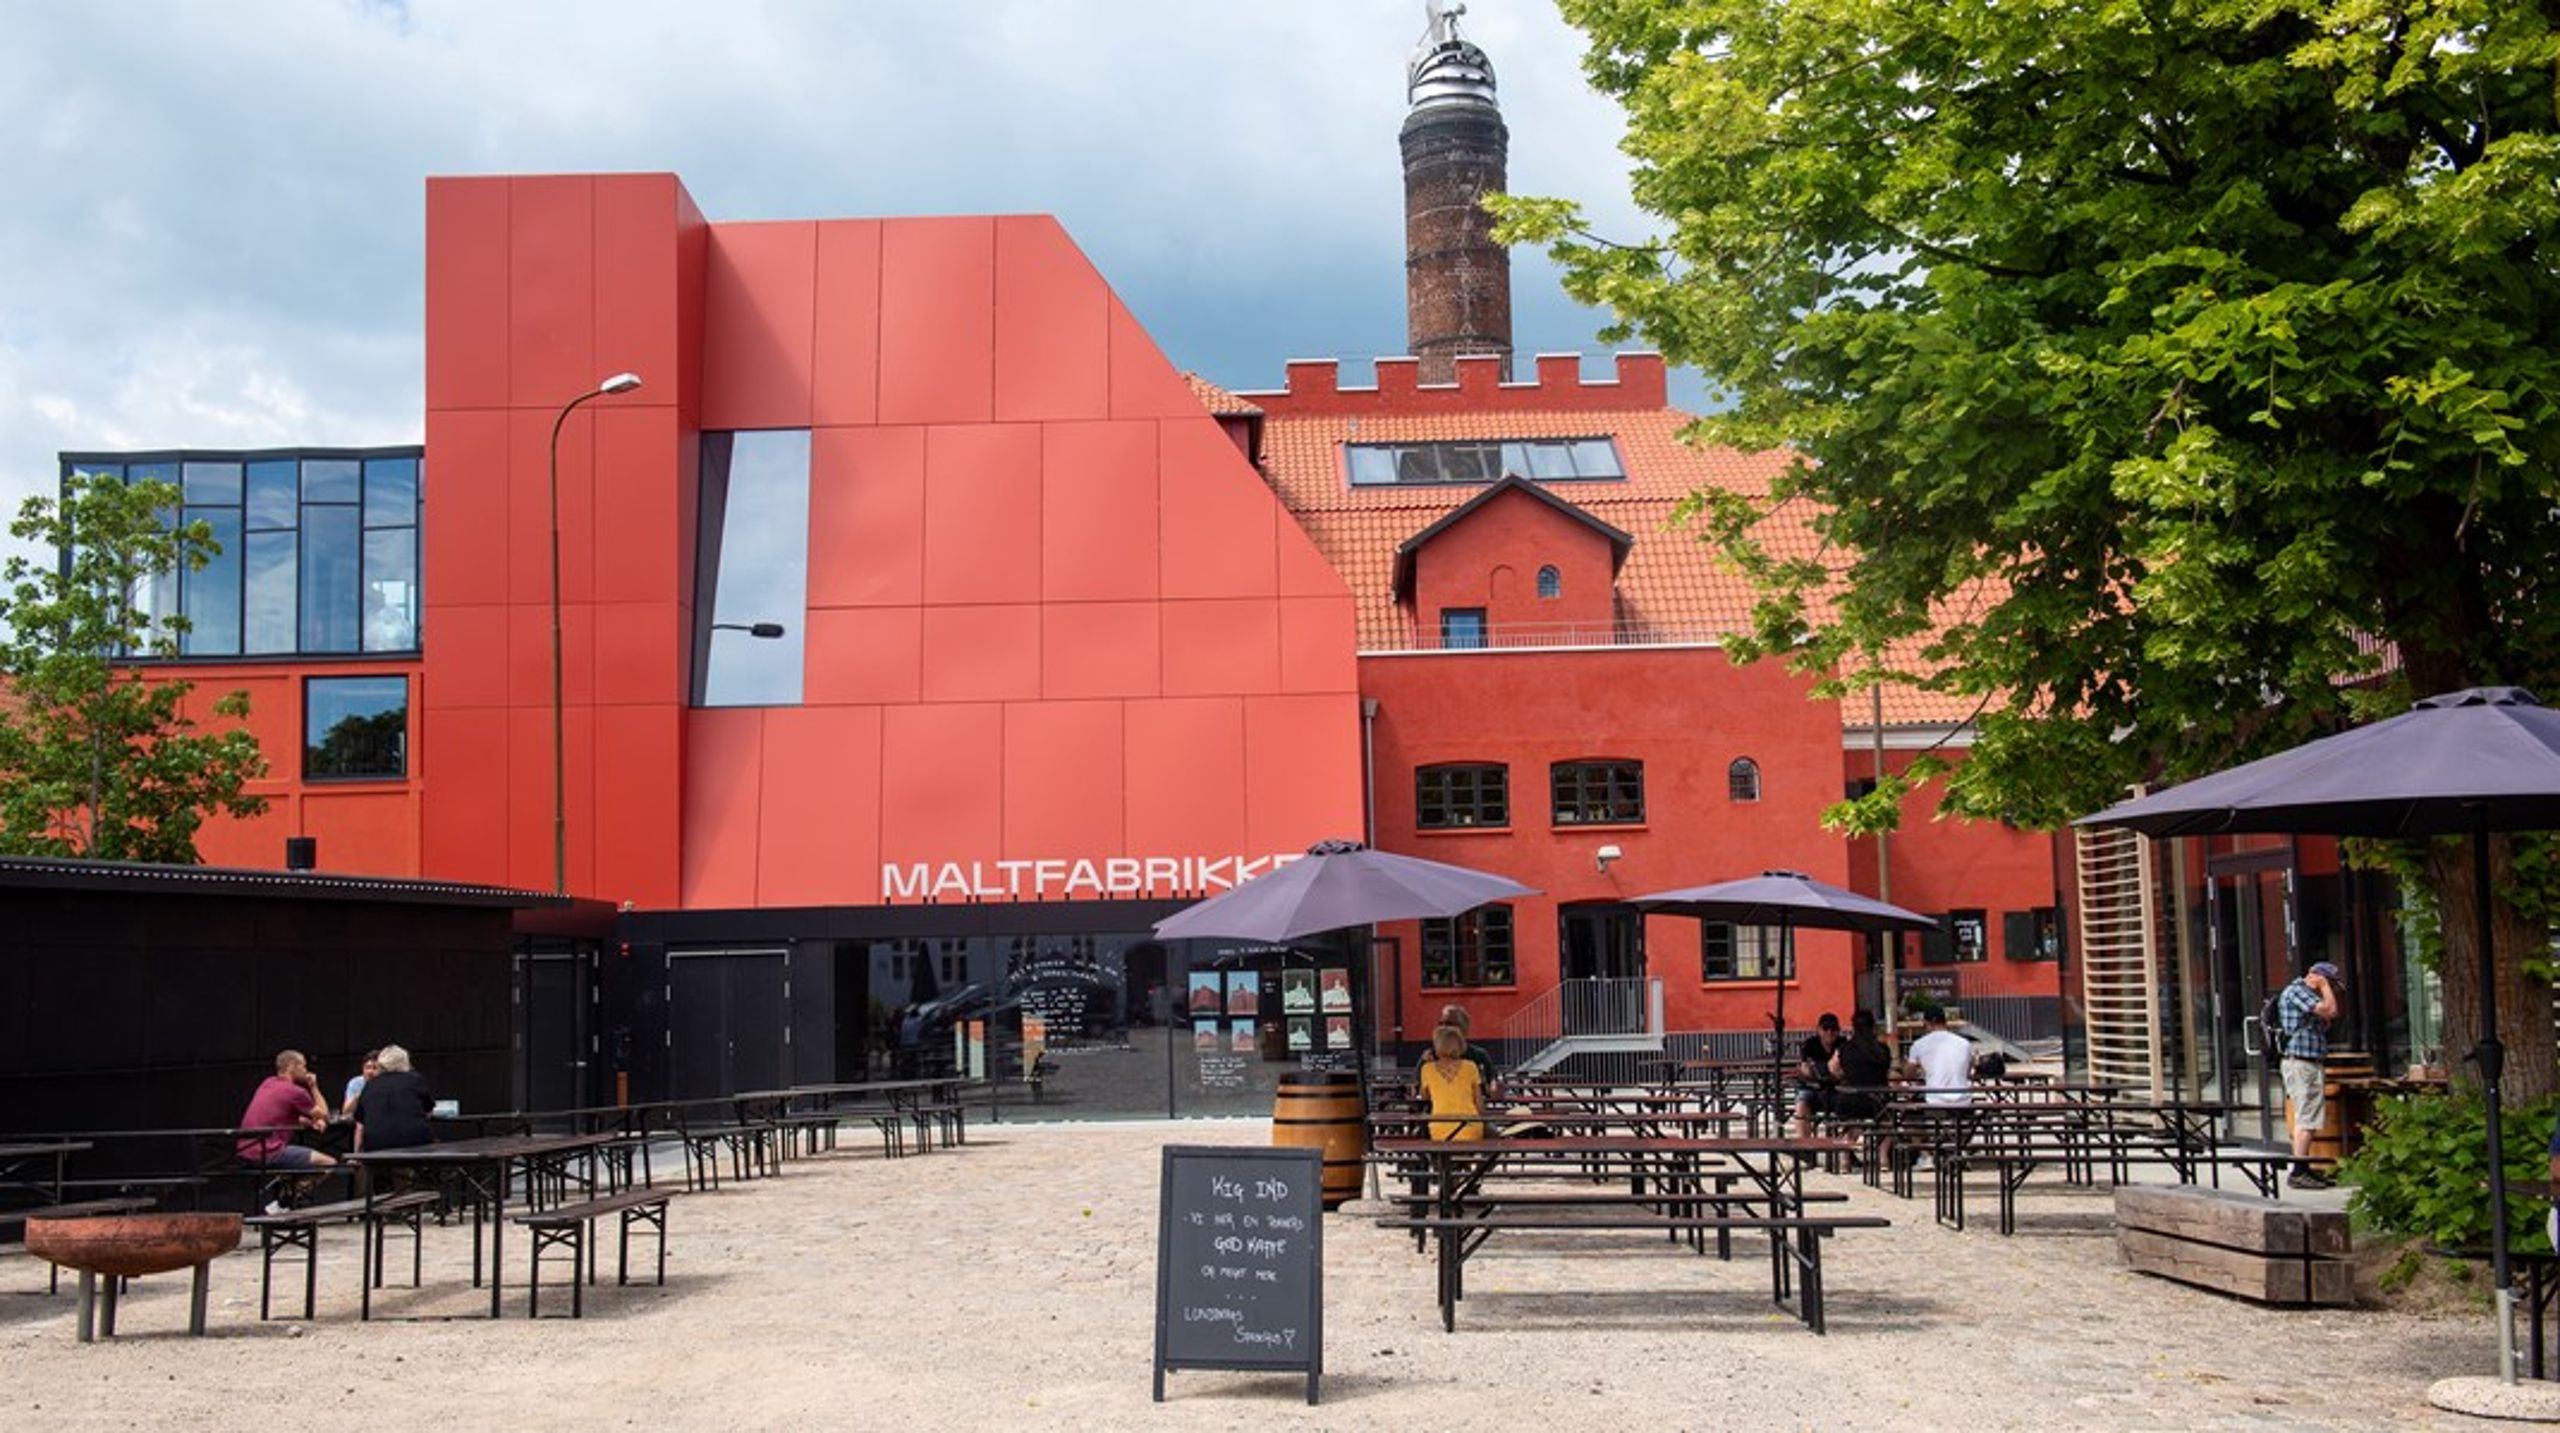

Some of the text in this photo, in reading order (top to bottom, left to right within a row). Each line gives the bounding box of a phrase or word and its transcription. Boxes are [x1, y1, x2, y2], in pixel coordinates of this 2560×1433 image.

[1211, 1175, 1289, 1203] KIG IND
[1214, 1236, 1243, 1256] GOD
